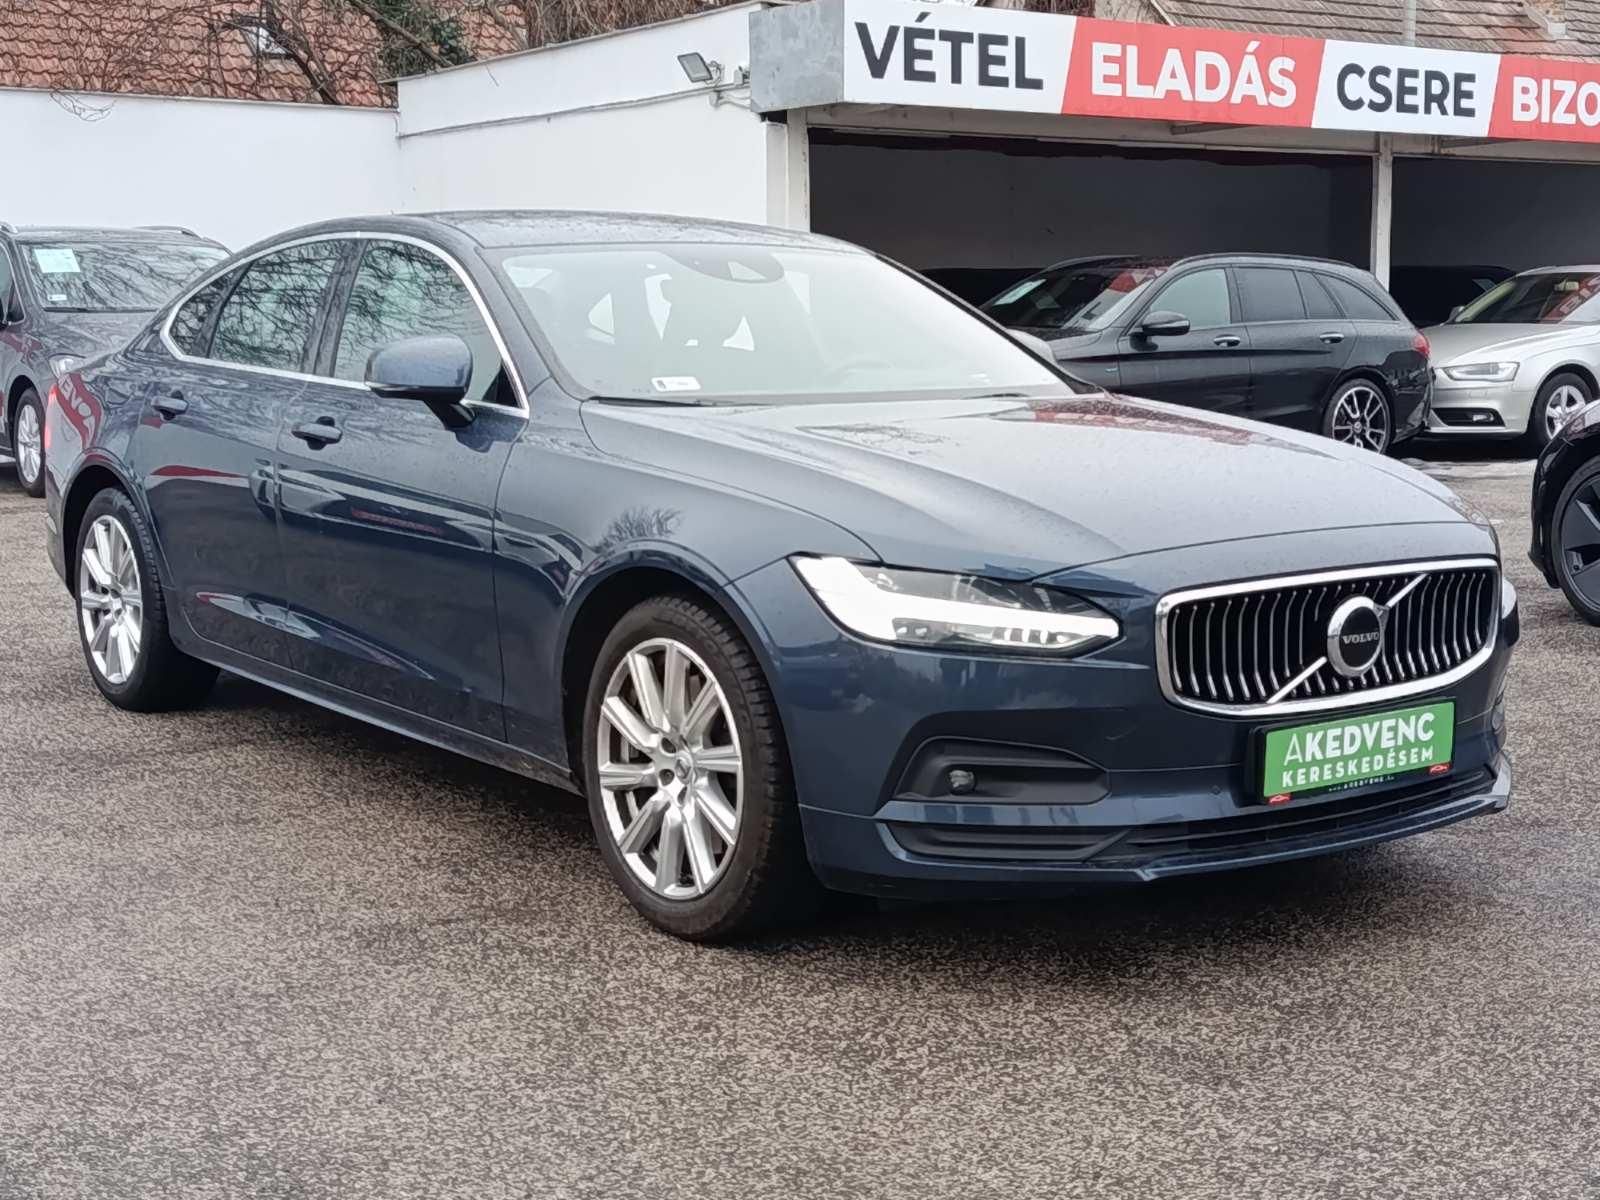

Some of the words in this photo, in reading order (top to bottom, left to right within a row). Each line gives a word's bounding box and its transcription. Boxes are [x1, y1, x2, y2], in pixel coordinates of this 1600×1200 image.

[854, 12, 1044, 90] VÉTEL
[1091, 41, 1297, 108] ELADÁS
[1336, 62, 1476, 118] CSERE
[1512, 76, 1600, 127] BIZO
[1342, 631, 1380, 645] VOLVO
[1282, 746, 1434, 788] KERESKEDÉSEM
